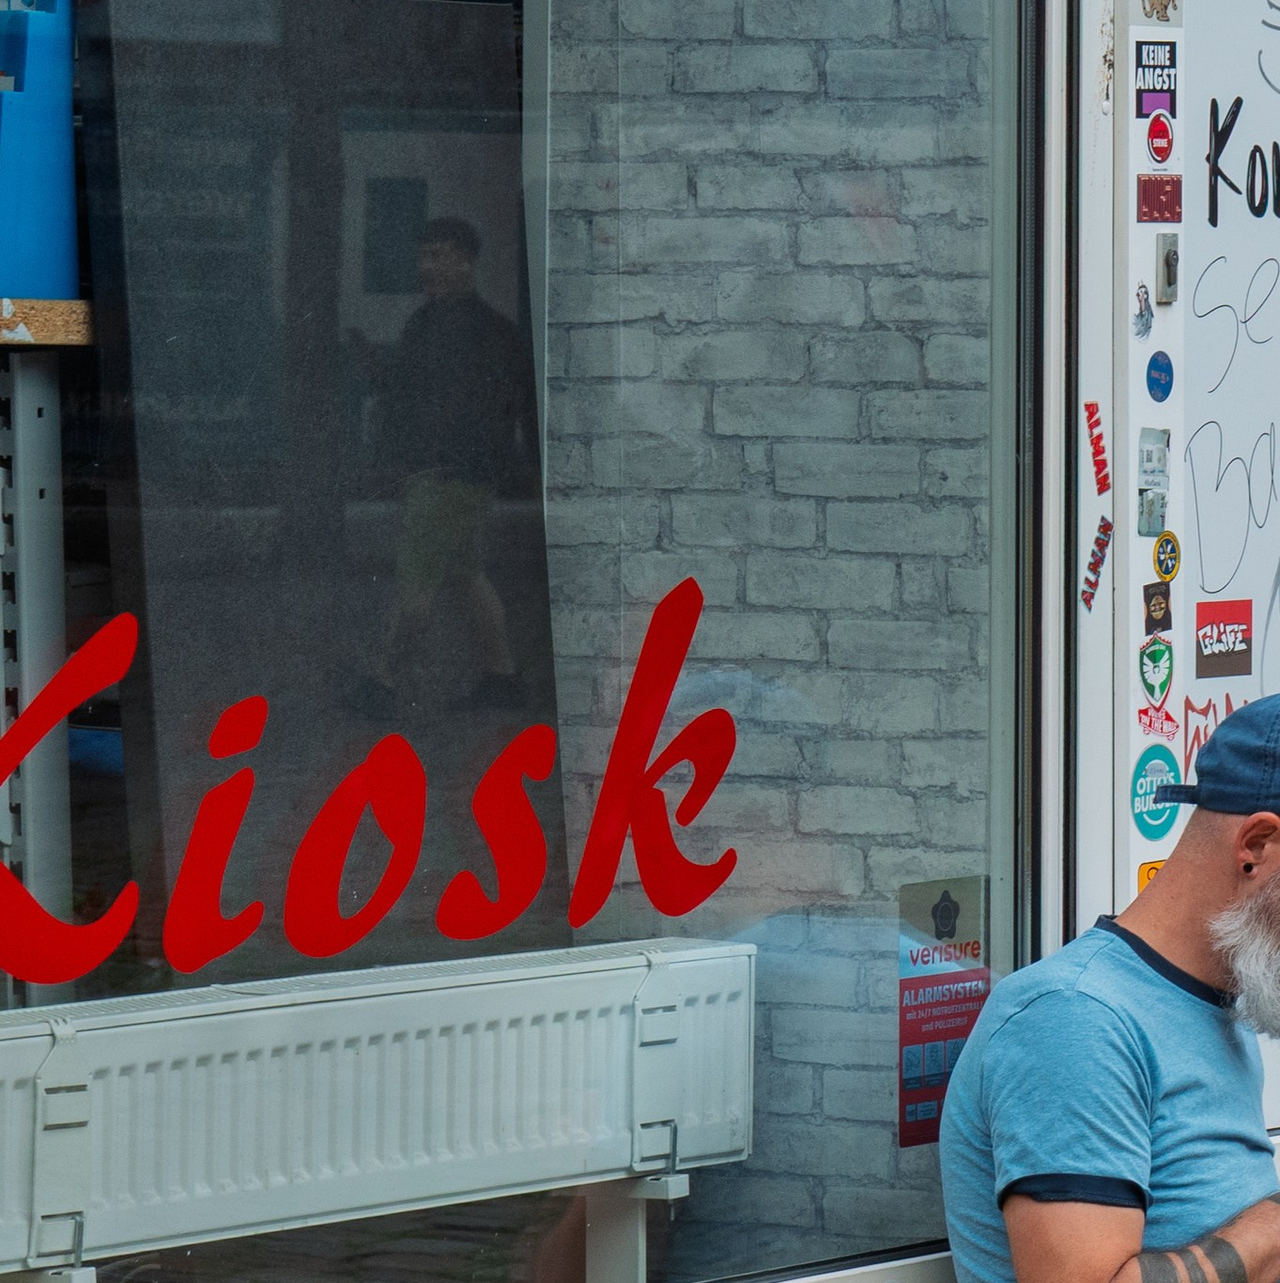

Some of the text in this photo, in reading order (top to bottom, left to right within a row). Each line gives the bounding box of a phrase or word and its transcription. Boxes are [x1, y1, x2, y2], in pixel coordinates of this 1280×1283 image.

[1141, 44, 1171, 66] KEINE
[1136, 68, 1177, 91] ANGST
[1084, 402, 1111, 496] ALMAN
[1081, 515, 1114, 613] ALMAN
[909, 939, 982, 967] verisure
